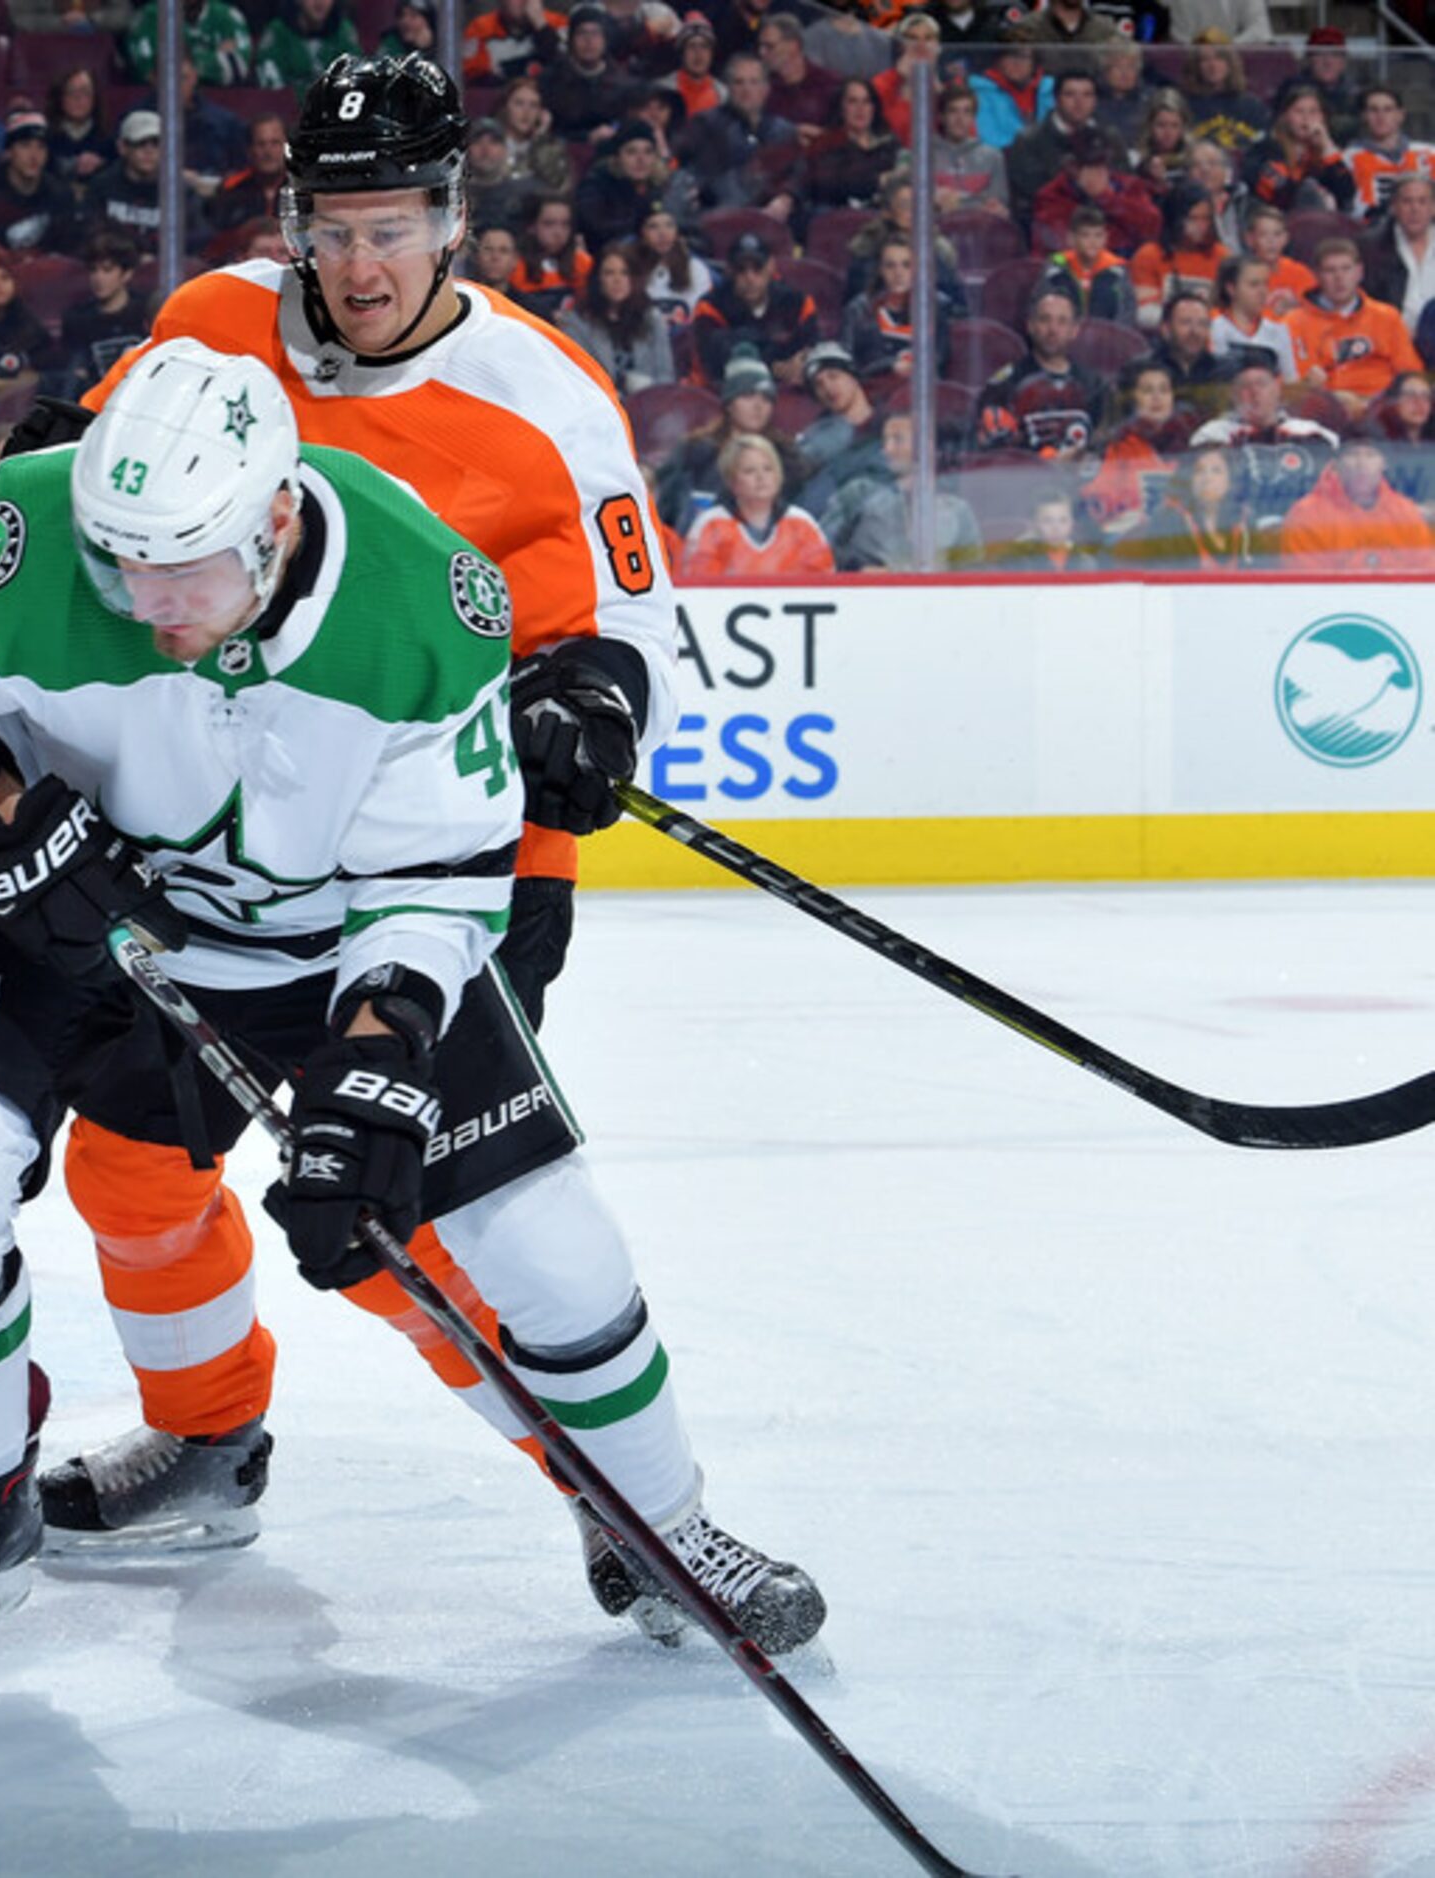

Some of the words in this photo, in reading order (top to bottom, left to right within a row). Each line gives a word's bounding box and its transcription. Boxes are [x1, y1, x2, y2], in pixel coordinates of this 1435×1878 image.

[338, 91, 365, 120] 8
[110, 457, 148, 496] 43
[596, 493, 655, 597] 8
[454, 678, 516, 799] 4
[422, 1083, 553, 1167] BAUER
